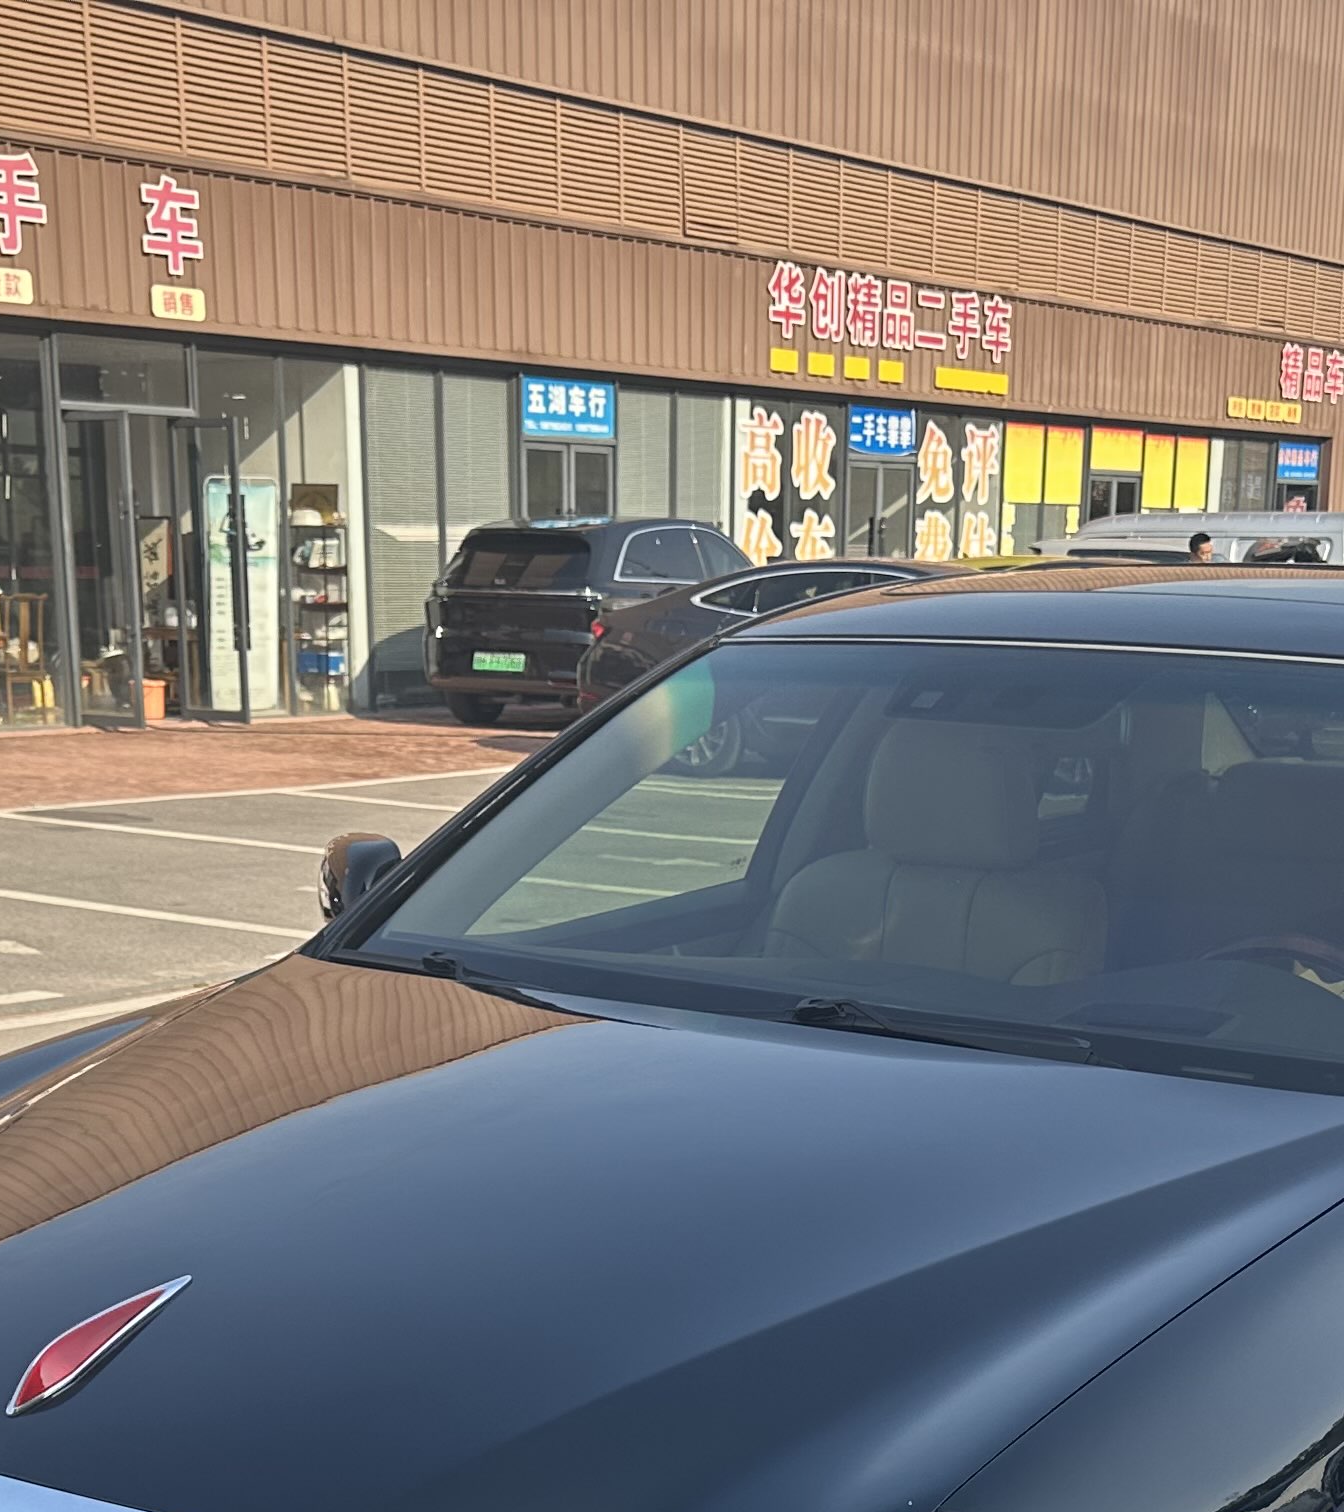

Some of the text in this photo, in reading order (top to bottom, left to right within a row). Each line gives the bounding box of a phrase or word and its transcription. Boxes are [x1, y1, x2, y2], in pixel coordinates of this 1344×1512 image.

[162, 290, 195, 317] 销售
[768, 260, 1012, 363] 华创精品二手车
